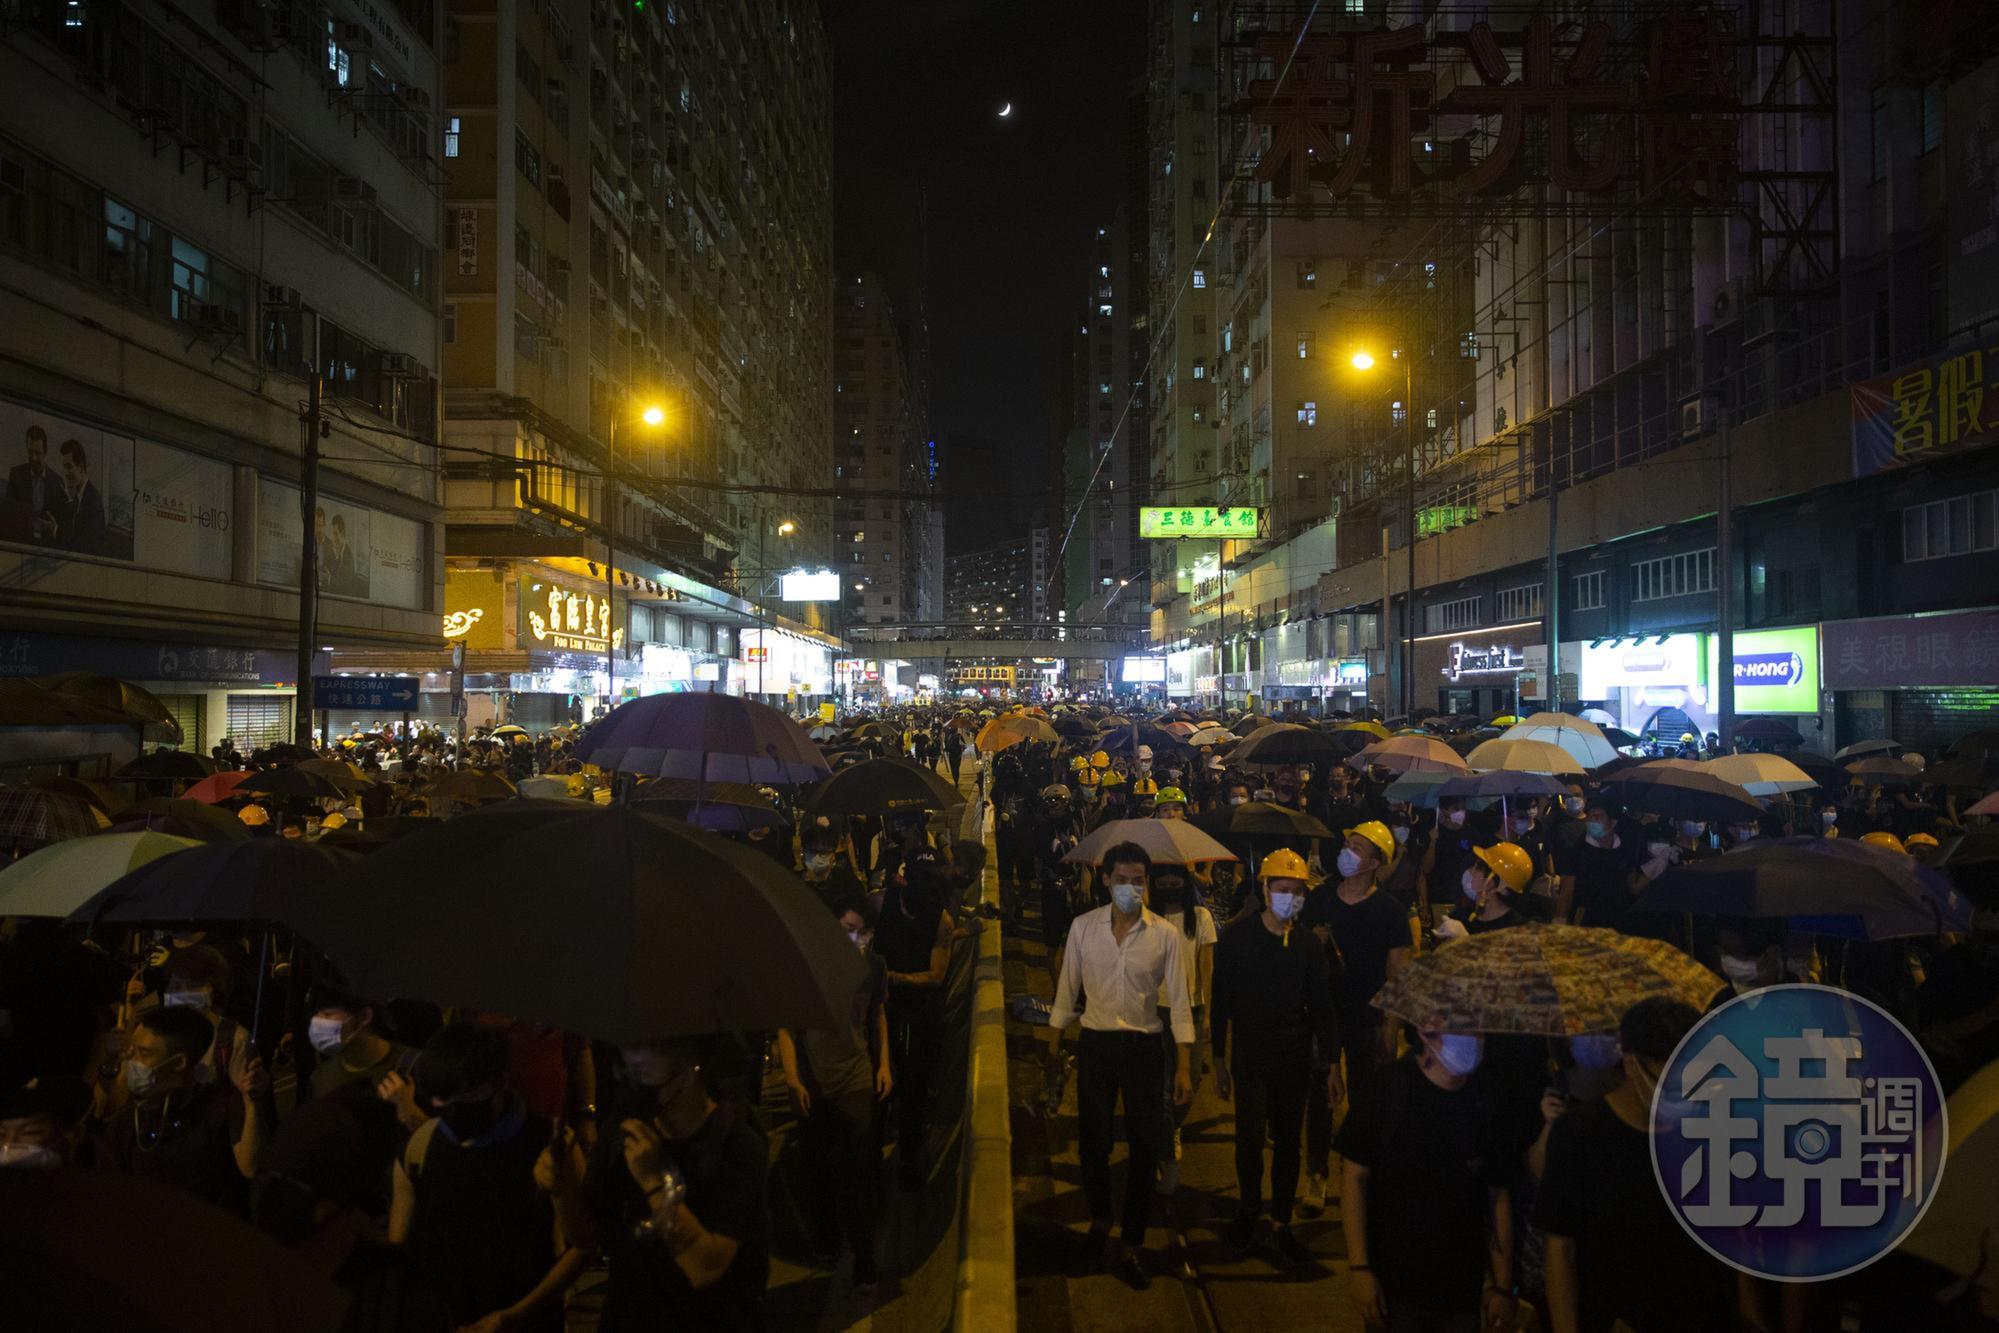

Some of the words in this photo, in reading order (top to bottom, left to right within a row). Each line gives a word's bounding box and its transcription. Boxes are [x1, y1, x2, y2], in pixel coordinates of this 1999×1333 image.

[1839, 631, 1999, 675] 美視眼鏡
[320, 680, 391, 689] EXPRESSWAY
[328, 692, 382, 705] 快速公路
